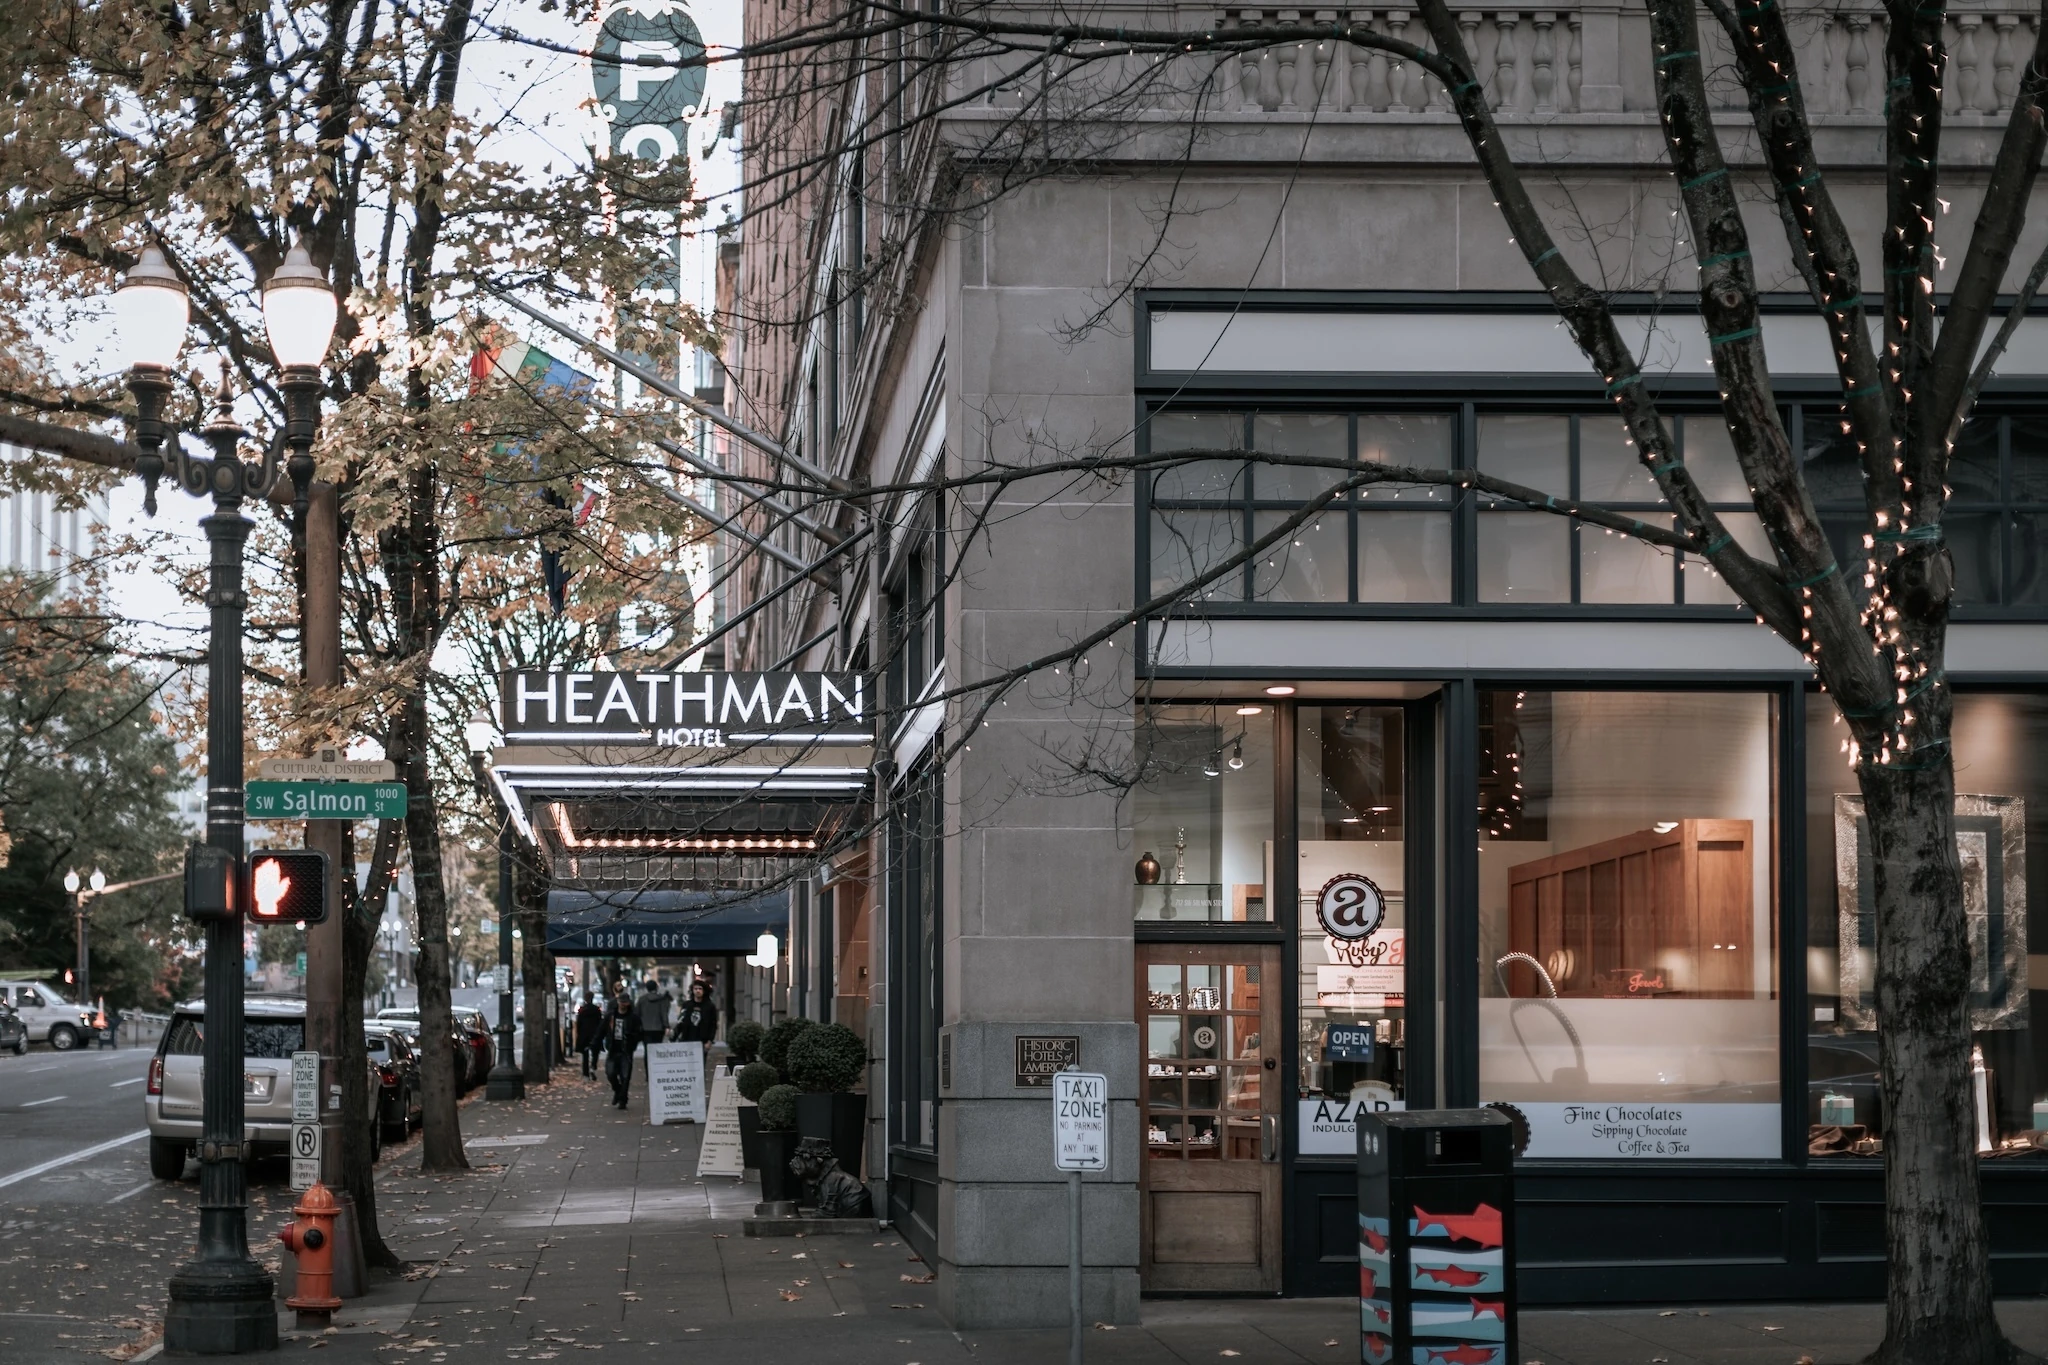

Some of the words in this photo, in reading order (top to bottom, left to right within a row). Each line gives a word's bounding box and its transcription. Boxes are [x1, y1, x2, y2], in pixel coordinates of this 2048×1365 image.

[516, 673, 864, 724] HEATHMAN
[656, 727, 726, 748] HOTEL
[273, 763, 329, 774] CULTURAL
[334, 764, 383, 775] DISTRICT
[375, 788, 398, 799] 1000
[256, 796, 274, 810] SW
[282, 790, 366, 812] Salmon
[375, 801, 385, 812] St
[586, 930, 690, 948] headwaters
[1331, 936, 1387, 968] Ruby
[1332, 1031, 1370, 1046] OPEN
[1024, 1040, 1070, 1051] HISTORIC
[1024, 1051, 1063, 1061] HOTELS
[1065, 1053, 1073, 1062] of
[295, 1058, 315, 1069] HOTEL
[1024, 1062, 1069, 1073] AMERICA
[296, 1070, 314, 1081] ZONE
[657, 1076, 696, 1084] BREAKFAST
[1062, 1080, 1097, 1098] TAXI
[295, 1100, 314, 1108] LOADING
[1060, 1101, 1102, 1118] ZONE
[1563, 1106, 1600, 1124] Fine
[1605, 1106, 1682, 1124] Chocolates
[1060, 1121, 1069, 1130] NO
[1074, 1121, 1102, 1131] PARKING
[1312, 1125, 1355, 1133] INDULG
[1591, 1124, 1633, 1139] Sipping
[1636, 1124, 1687, 1138] Chocolate
[1076, 1133, 1084, 1142] AT
[1063, 1144, 1077, 1153] ANY
[1083, 1144, 1099, 1154] TIME
[1618, 1140, 1652, 1156] Coffee
[1656, 1141, 1666, 1154] &
[1668, 1141, 1690, 1154] Tea
